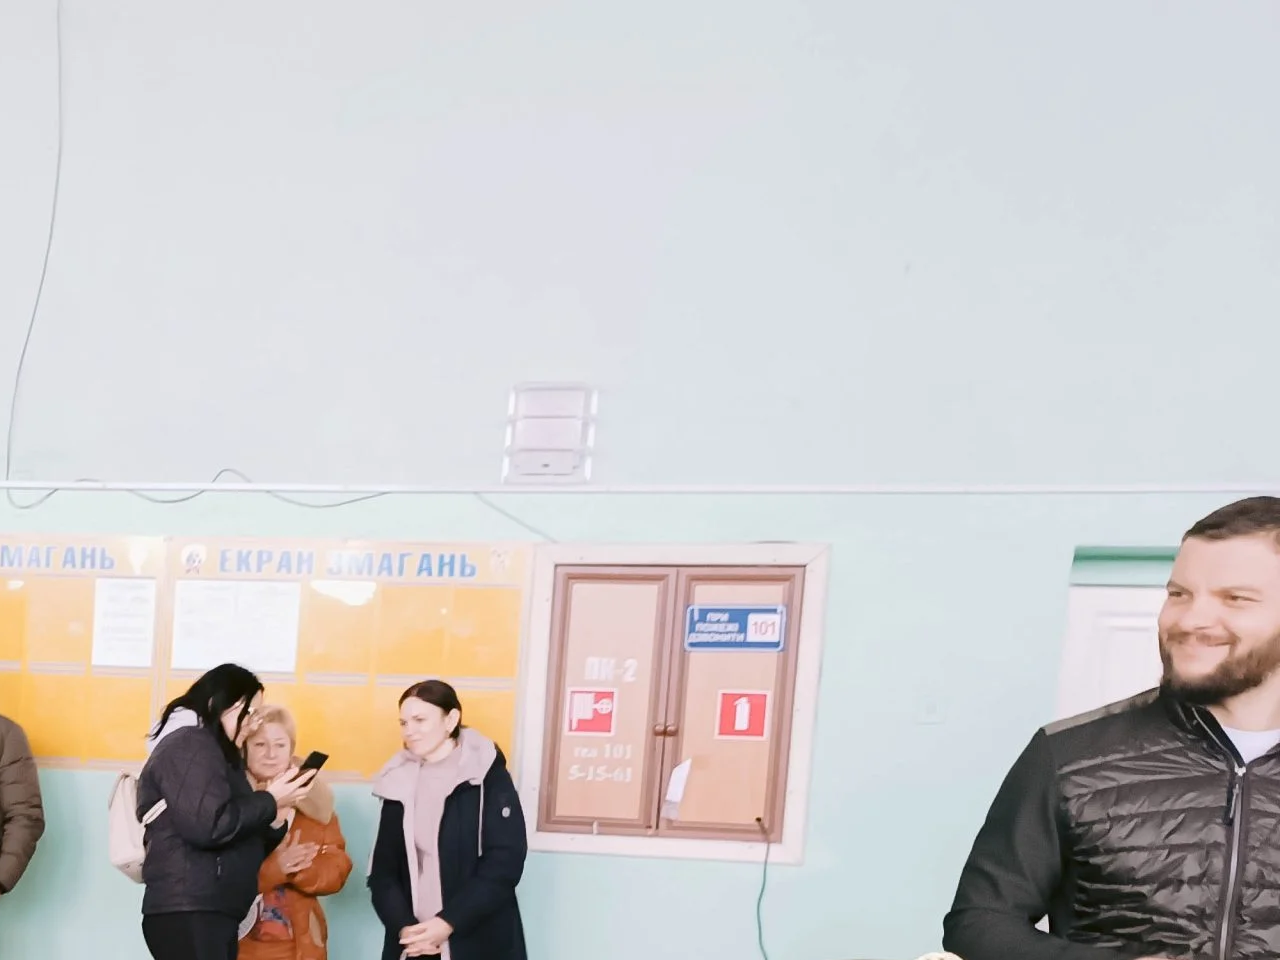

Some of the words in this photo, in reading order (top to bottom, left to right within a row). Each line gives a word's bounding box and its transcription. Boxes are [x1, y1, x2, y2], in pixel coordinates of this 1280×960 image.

[218, 548, 315, 575] ЕКРАН
[327, 550, 478, 578] ЗМАГАНЬ
[751, 620, 777, 636] 101
